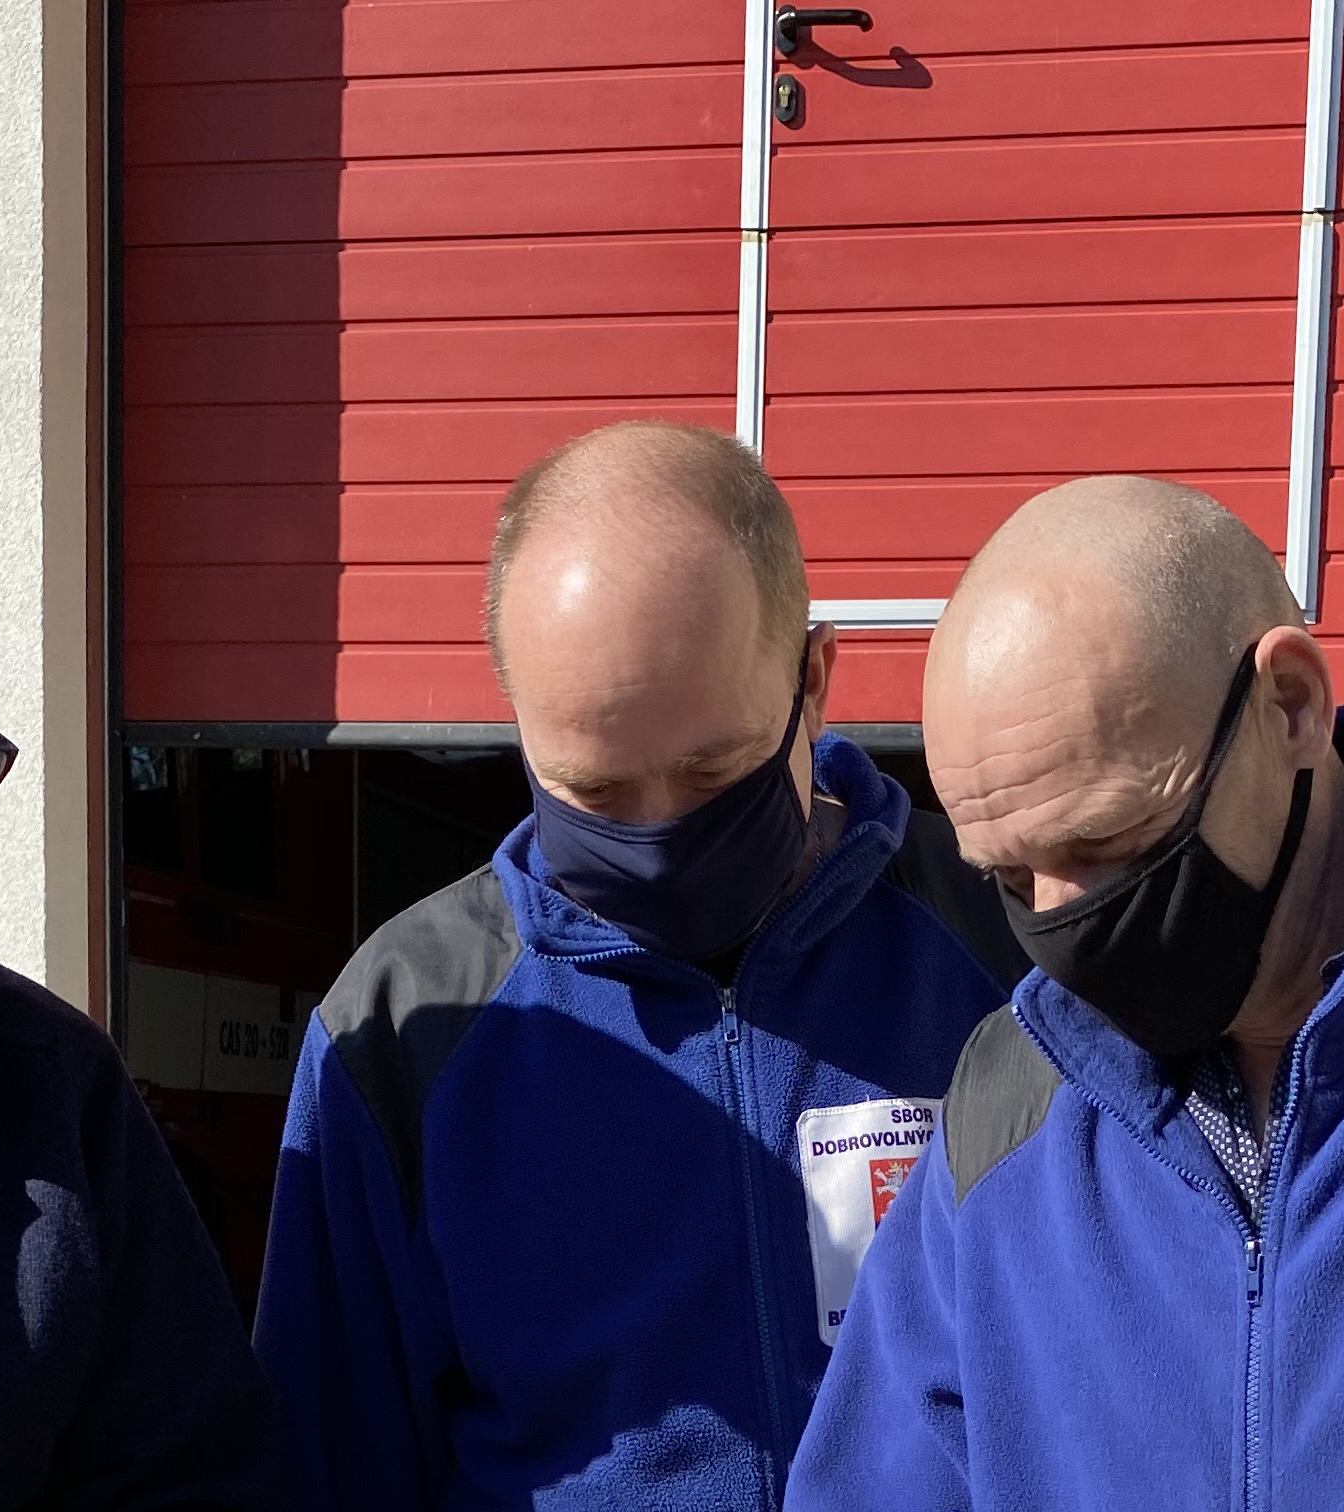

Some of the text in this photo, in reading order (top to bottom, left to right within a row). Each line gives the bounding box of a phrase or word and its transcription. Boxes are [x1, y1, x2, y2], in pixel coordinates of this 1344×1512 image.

[220, 1020, 240, 1057] CAS
[891, 1108, 934, 1124] SBOR
[812, 1125, 935, 1157] DOBROVOLNÝC
